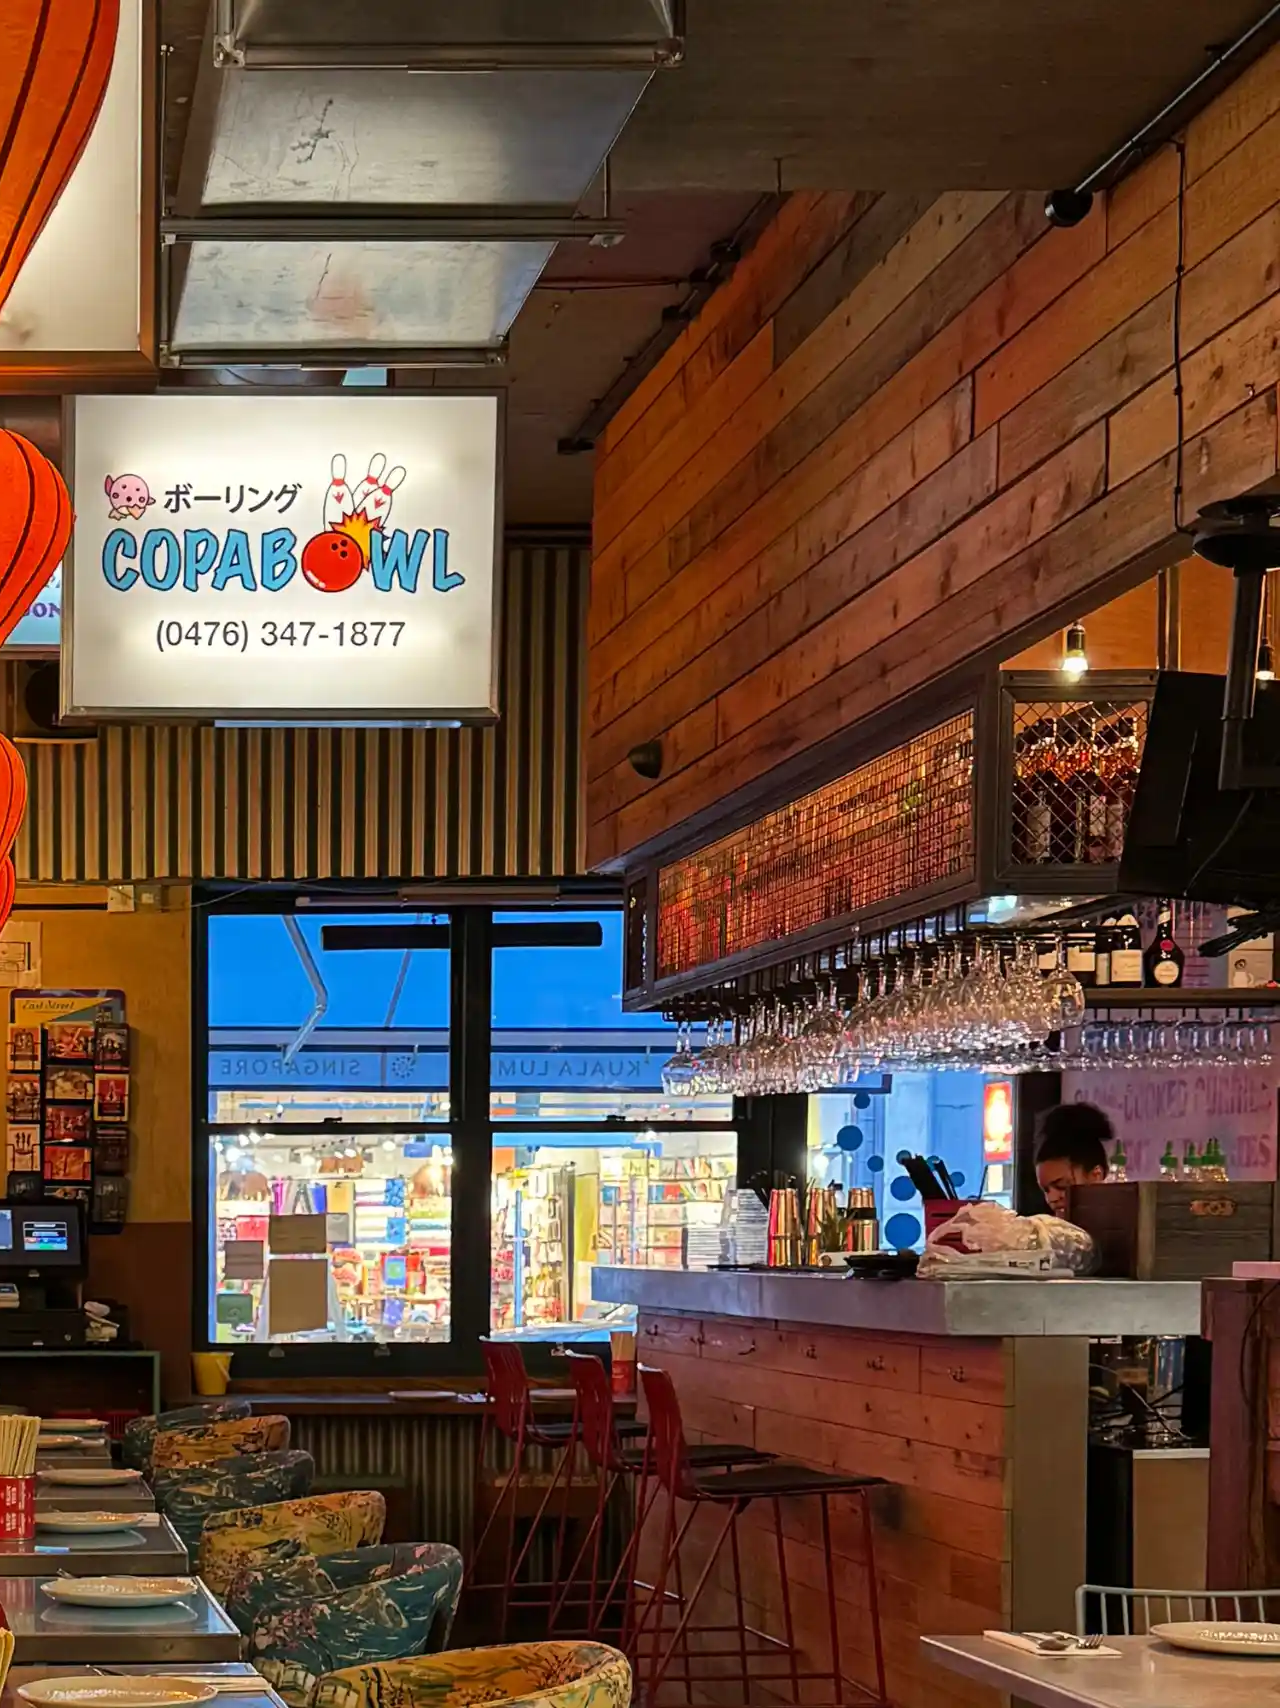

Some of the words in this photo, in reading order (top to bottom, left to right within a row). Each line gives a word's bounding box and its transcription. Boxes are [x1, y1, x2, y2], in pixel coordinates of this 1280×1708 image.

[163, 482, 303, 514] ボーリング
[156, 619, 249, 653] (0476)
[260, 620, 406, 647] 347-1877
